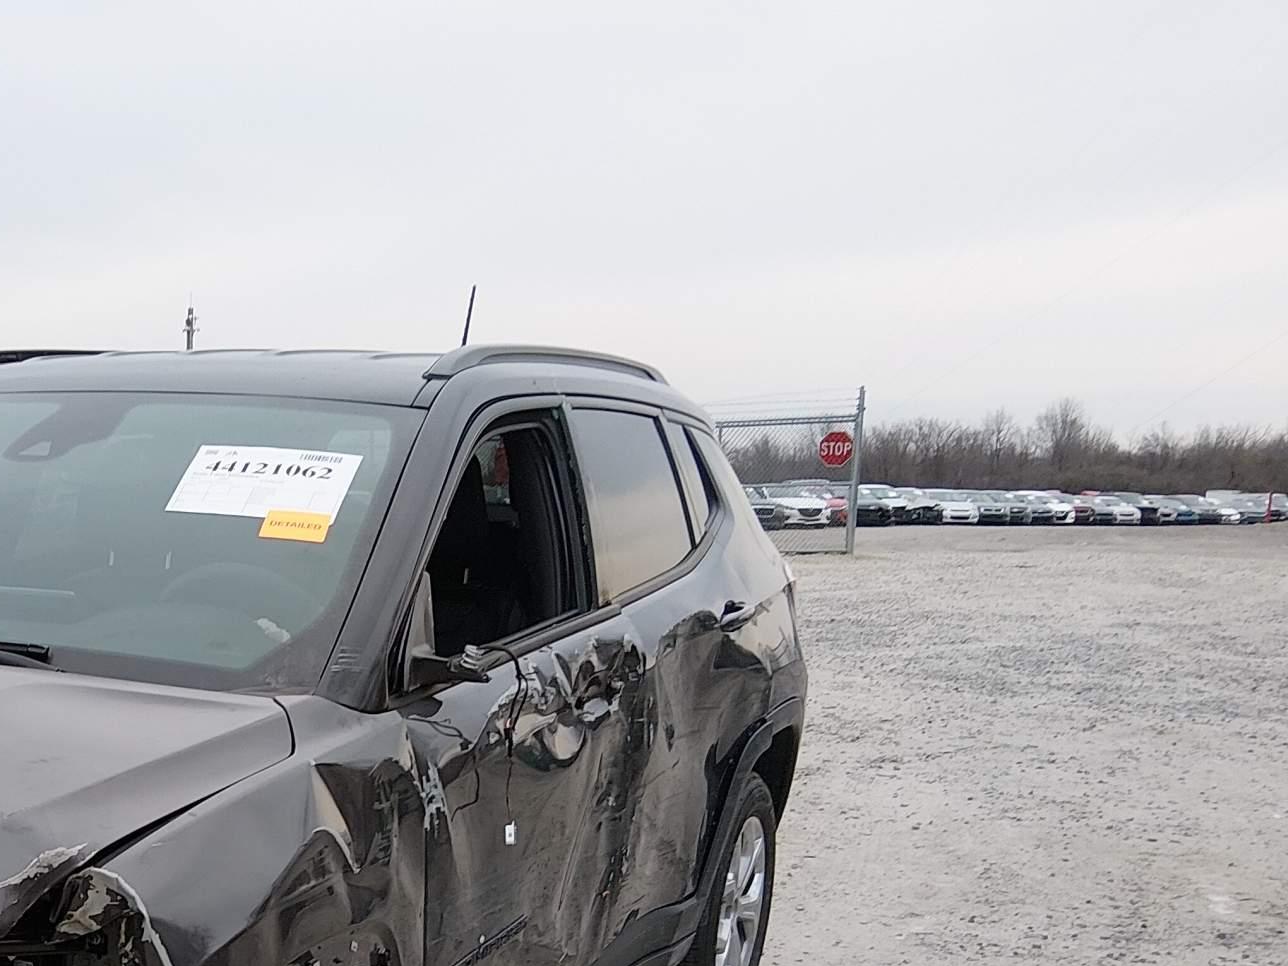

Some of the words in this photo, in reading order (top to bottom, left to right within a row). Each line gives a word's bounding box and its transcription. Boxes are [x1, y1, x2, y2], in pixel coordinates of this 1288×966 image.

[820, 441, 852, 456] STOP
[205, 460, 333, 480] 44121062
[269, 519, 322, 531] DETAILED
